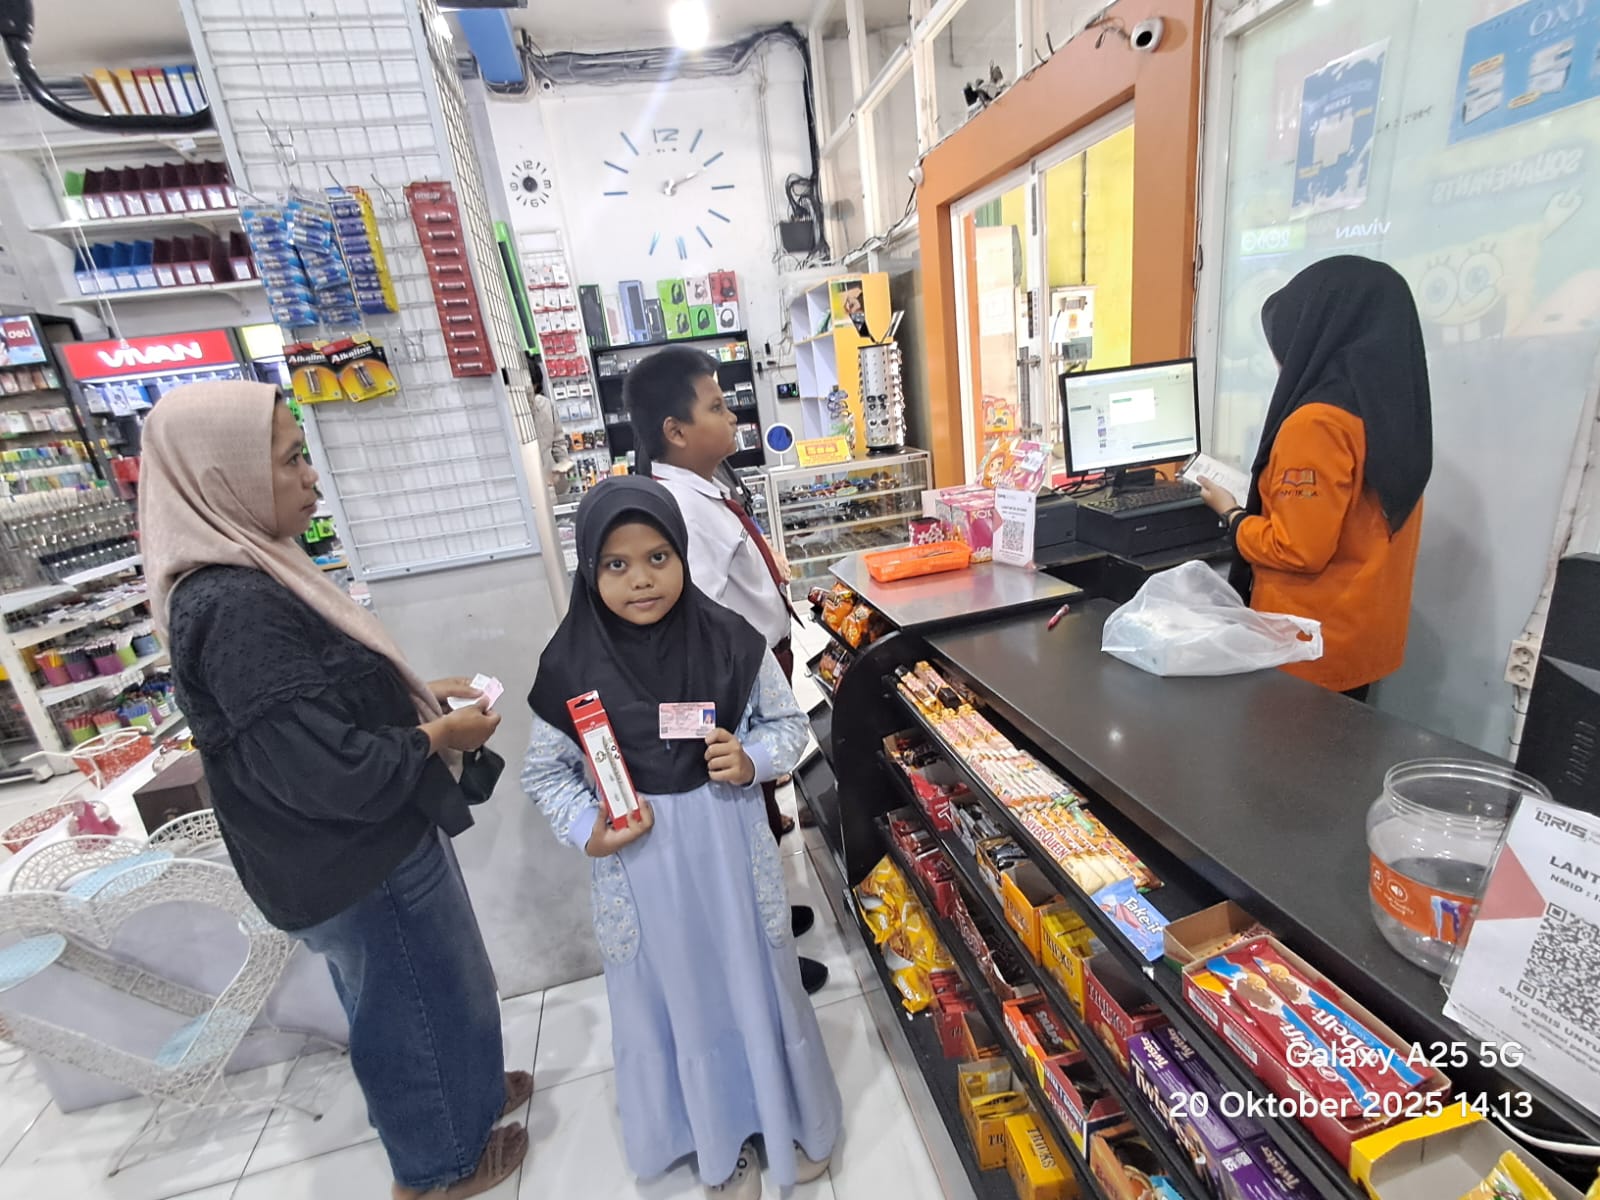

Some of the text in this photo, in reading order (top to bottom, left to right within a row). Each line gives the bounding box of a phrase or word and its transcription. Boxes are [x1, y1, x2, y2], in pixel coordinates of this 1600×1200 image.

[288, 354, 325, 364] Alkalin
[331, 343, 372, 363] Alkaline
[1535, 808, 1588, 839] QRIS
[1550, 873, 1583, 893] NMID
[1124, 896, 1163, 934] Take-it
[1167, 1027, 1196, 1060] Twister
[1311, 1008, 1360, 1051] Delfi
[1140, 1036, 1169, 1069] Twister
[1261, 1145, 1300, 1189] Twister
